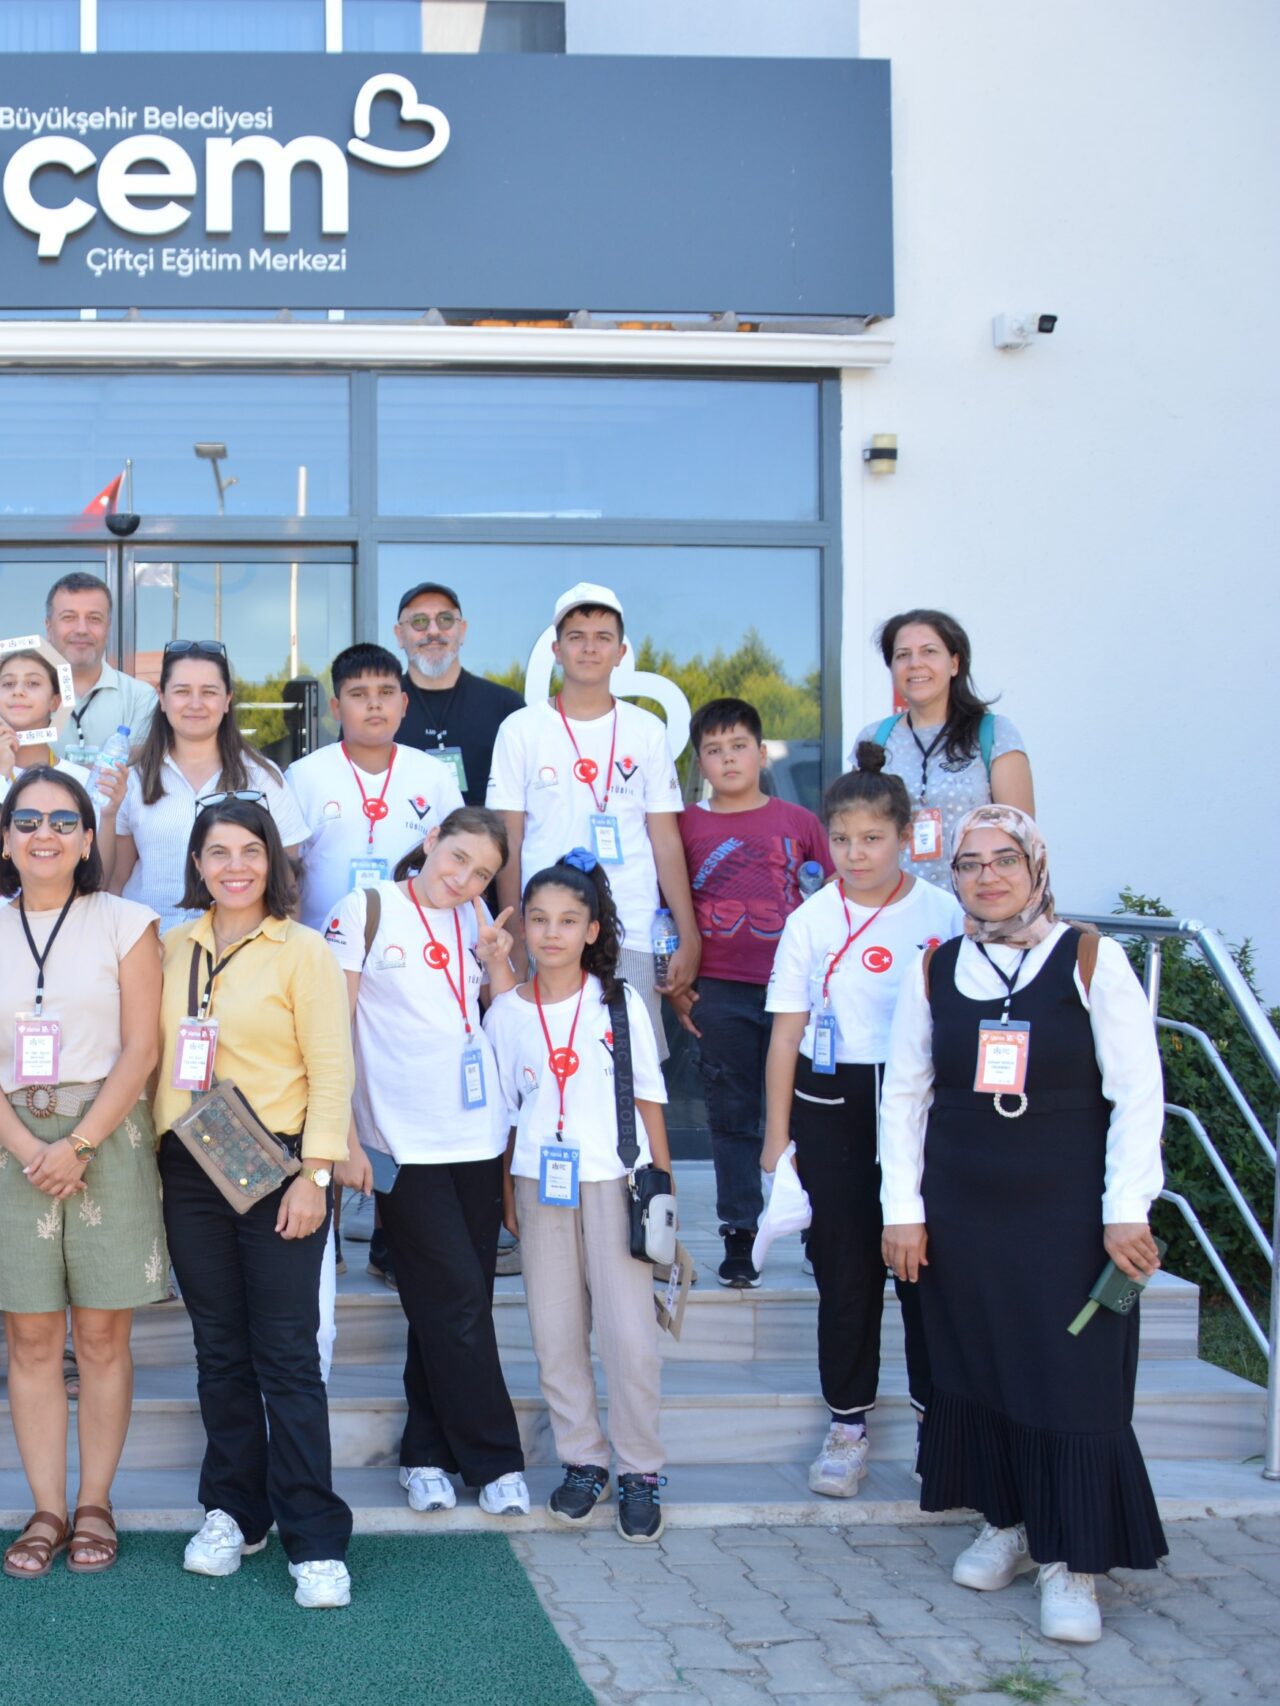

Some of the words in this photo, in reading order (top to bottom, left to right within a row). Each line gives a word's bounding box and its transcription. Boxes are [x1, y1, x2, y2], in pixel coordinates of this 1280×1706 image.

[143, 106, 273, 136] Belediyesi
[85, 247, 154, 276] Çiftçi
[161, 247, 242, 275] Eğitim
[248, 247, 348, 272] Merkezi
[692, 837, 745, 891] AWESOME
[612, 1010, 628, 1063] MARC
[618, 1071, 634, 1146] JACOBS
